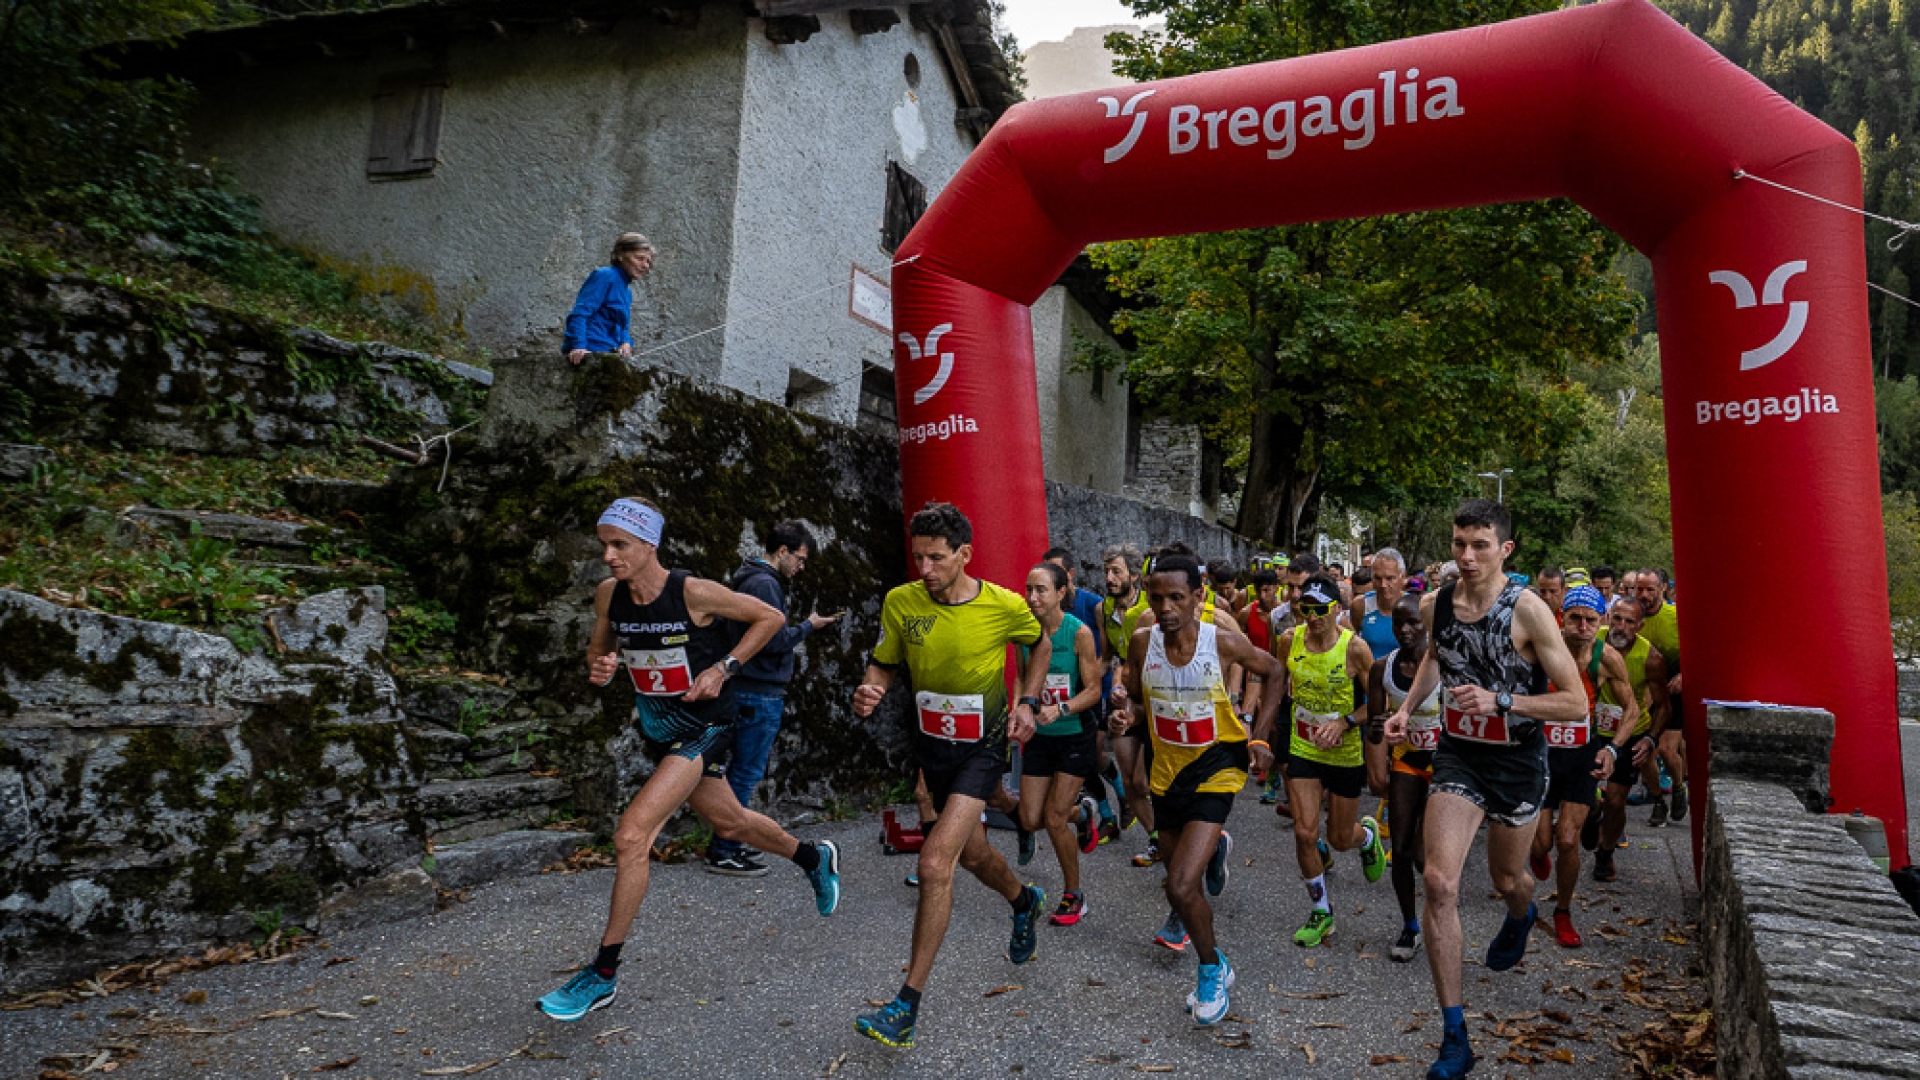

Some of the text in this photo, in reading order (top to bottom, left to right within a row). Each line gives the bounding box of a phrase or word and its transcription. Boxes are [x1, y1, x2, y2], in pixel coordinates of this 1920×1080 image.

[1168, 68, 1464, 160] Bregaglia
[1696, 387, 1839, 425] Bregaglia
[619, 622, 687, 633] SCARPA
[649, 670, 667, 692] 2
[1042, 689, 1061, 705] 01
[940, 714, 957, 736] 3
[1176, 722, 1189, 743] 1
[1458, 713, 1489, 738] 47
[1550, 726, 1576, 745] 66
[1410, 730, 1437, 748] 02
